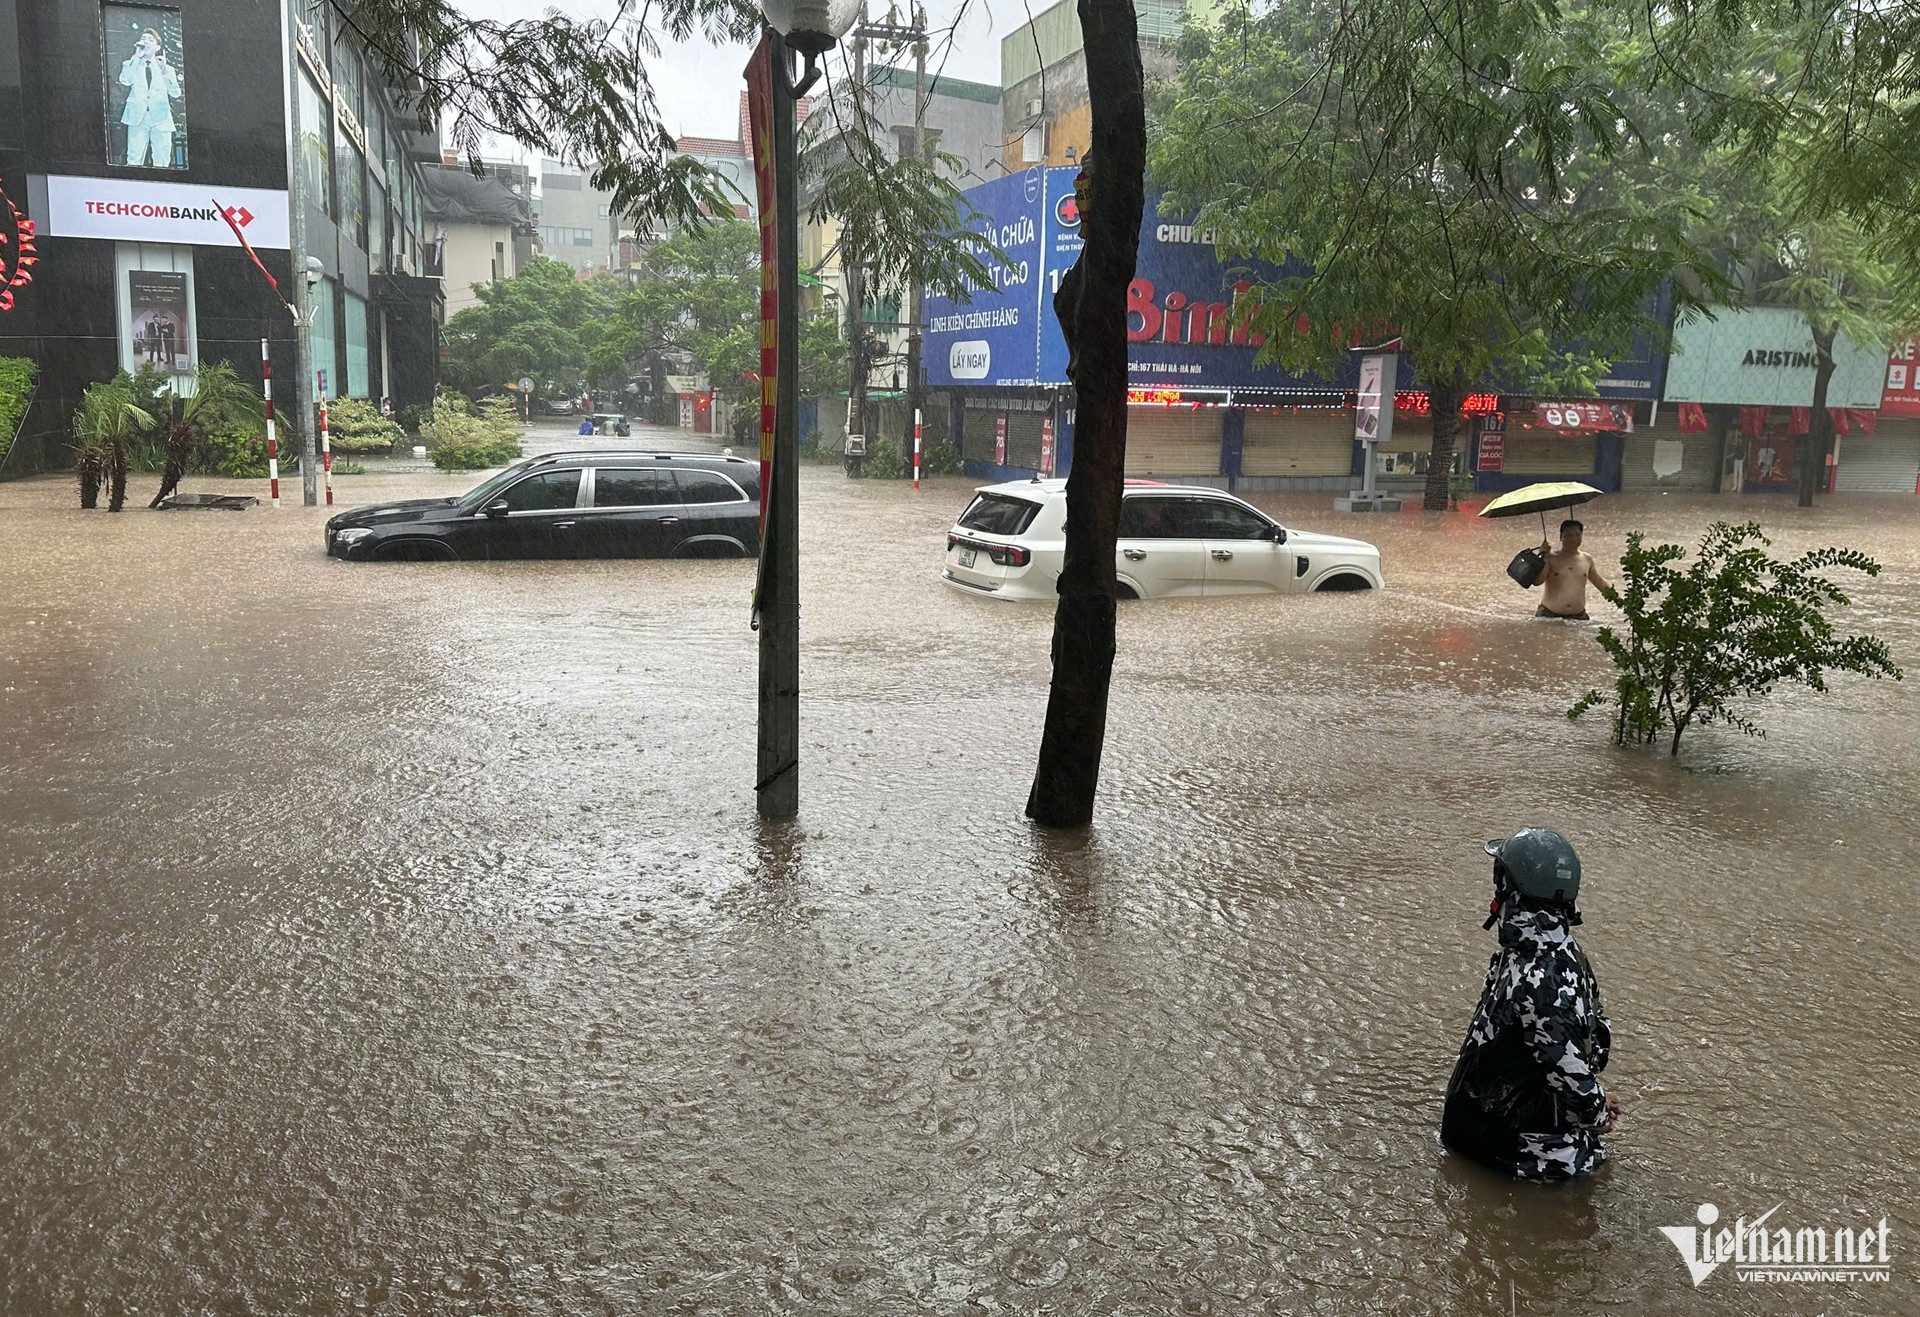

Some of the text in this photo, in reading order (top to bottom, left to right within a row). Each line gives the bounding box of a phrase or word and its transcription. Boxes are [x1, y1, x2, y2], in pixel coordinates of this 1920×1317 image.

[85, 201, 218, 221] TECHCOMBANK
[1001, 215, 1035, 249] CHỮA
[1003, 260, 1029, 287] CAO
[930, 317, 947, 333] LINH
[948, 312, 964, 334] KIỆN
[965, 310, 991, 330] CHÍNH
[952, 348, 988, 369] LẤY NGAY
[1152, 361, 1168, 373] THÁI
